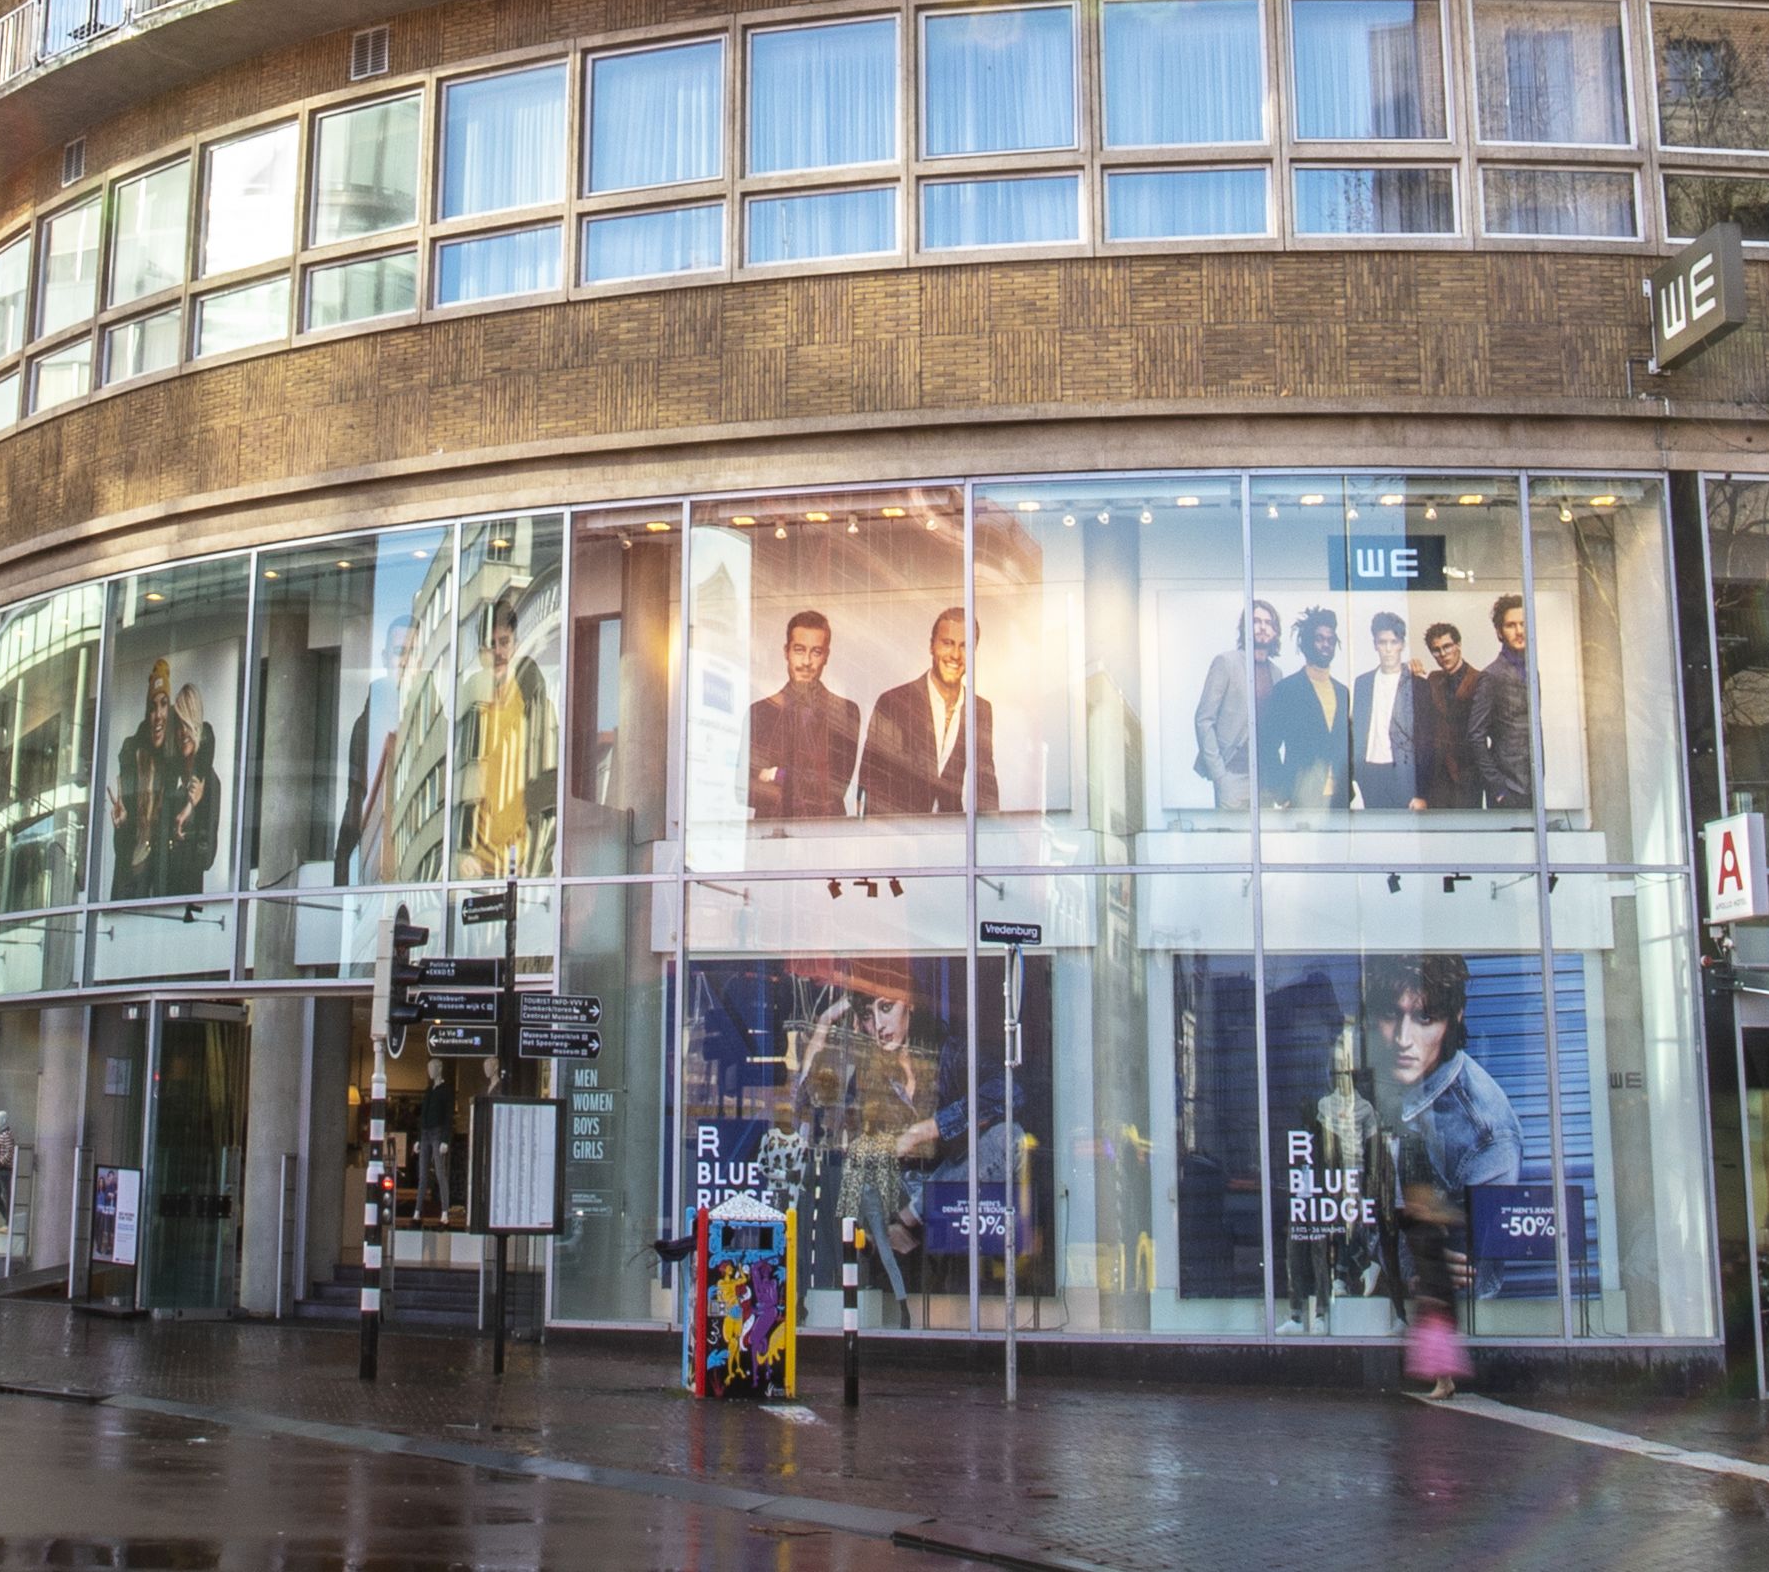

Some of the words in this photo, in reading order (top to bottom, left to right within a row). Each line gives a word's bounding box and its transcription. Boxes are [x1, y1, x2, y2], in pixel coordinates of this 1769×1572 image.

[1661, 253, 1716, 340] WE
[1357, 548, 1419, 578] WE
[985, 924, 1038, 938] Vredenburg
[574, 1068, 598, 1088] MEN
[1610, 1072, 1642, 1089] WE
[573, 1093, 613, 1111] WOMEN
[573, 1117, 600, 1135] BOYS
[573, 1141, 604, 1160] GIRLS
[697, 1162, 760, 1185] BLUE
[1289, 1168, 1360, 1194] BLUE
[1290, 1197, 1377, 1224] RIDGE
[1534, 1207, 1555, 1215] JEANS
[1501, 1216, 1556, 1237] -50%
[1291, 1233, 1309, 1241] FROM
